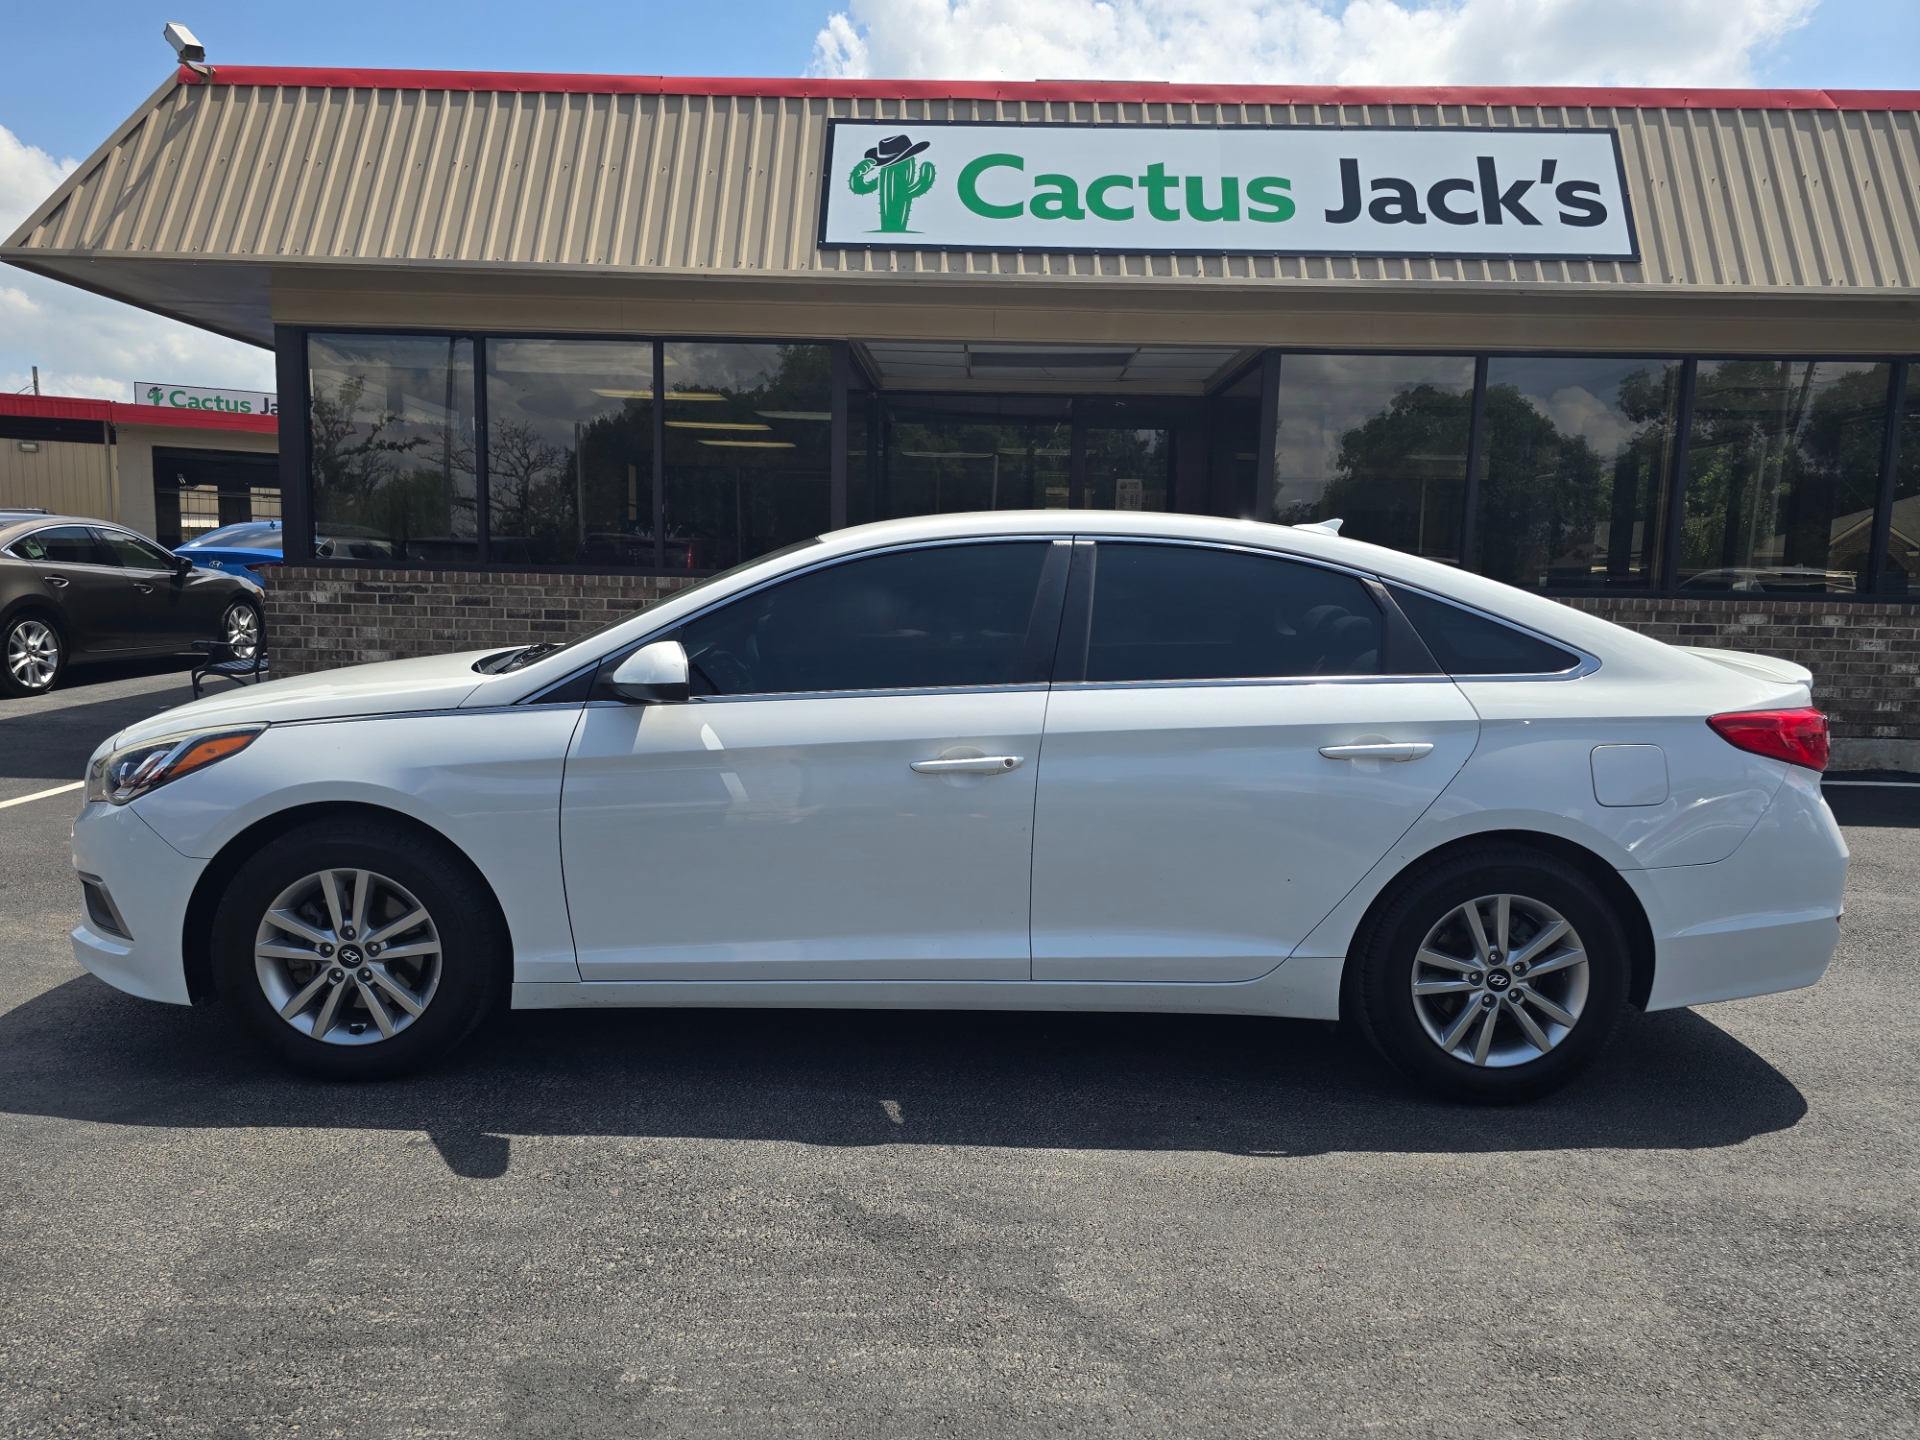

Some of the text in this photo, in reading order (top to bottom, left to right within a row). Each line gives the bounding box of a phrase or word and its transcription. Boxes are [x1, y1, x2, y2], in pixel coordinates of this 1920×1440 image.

[957, 153, 1608, 228] Cactus Jack's
[169, 390, 252, 414] Cactus
